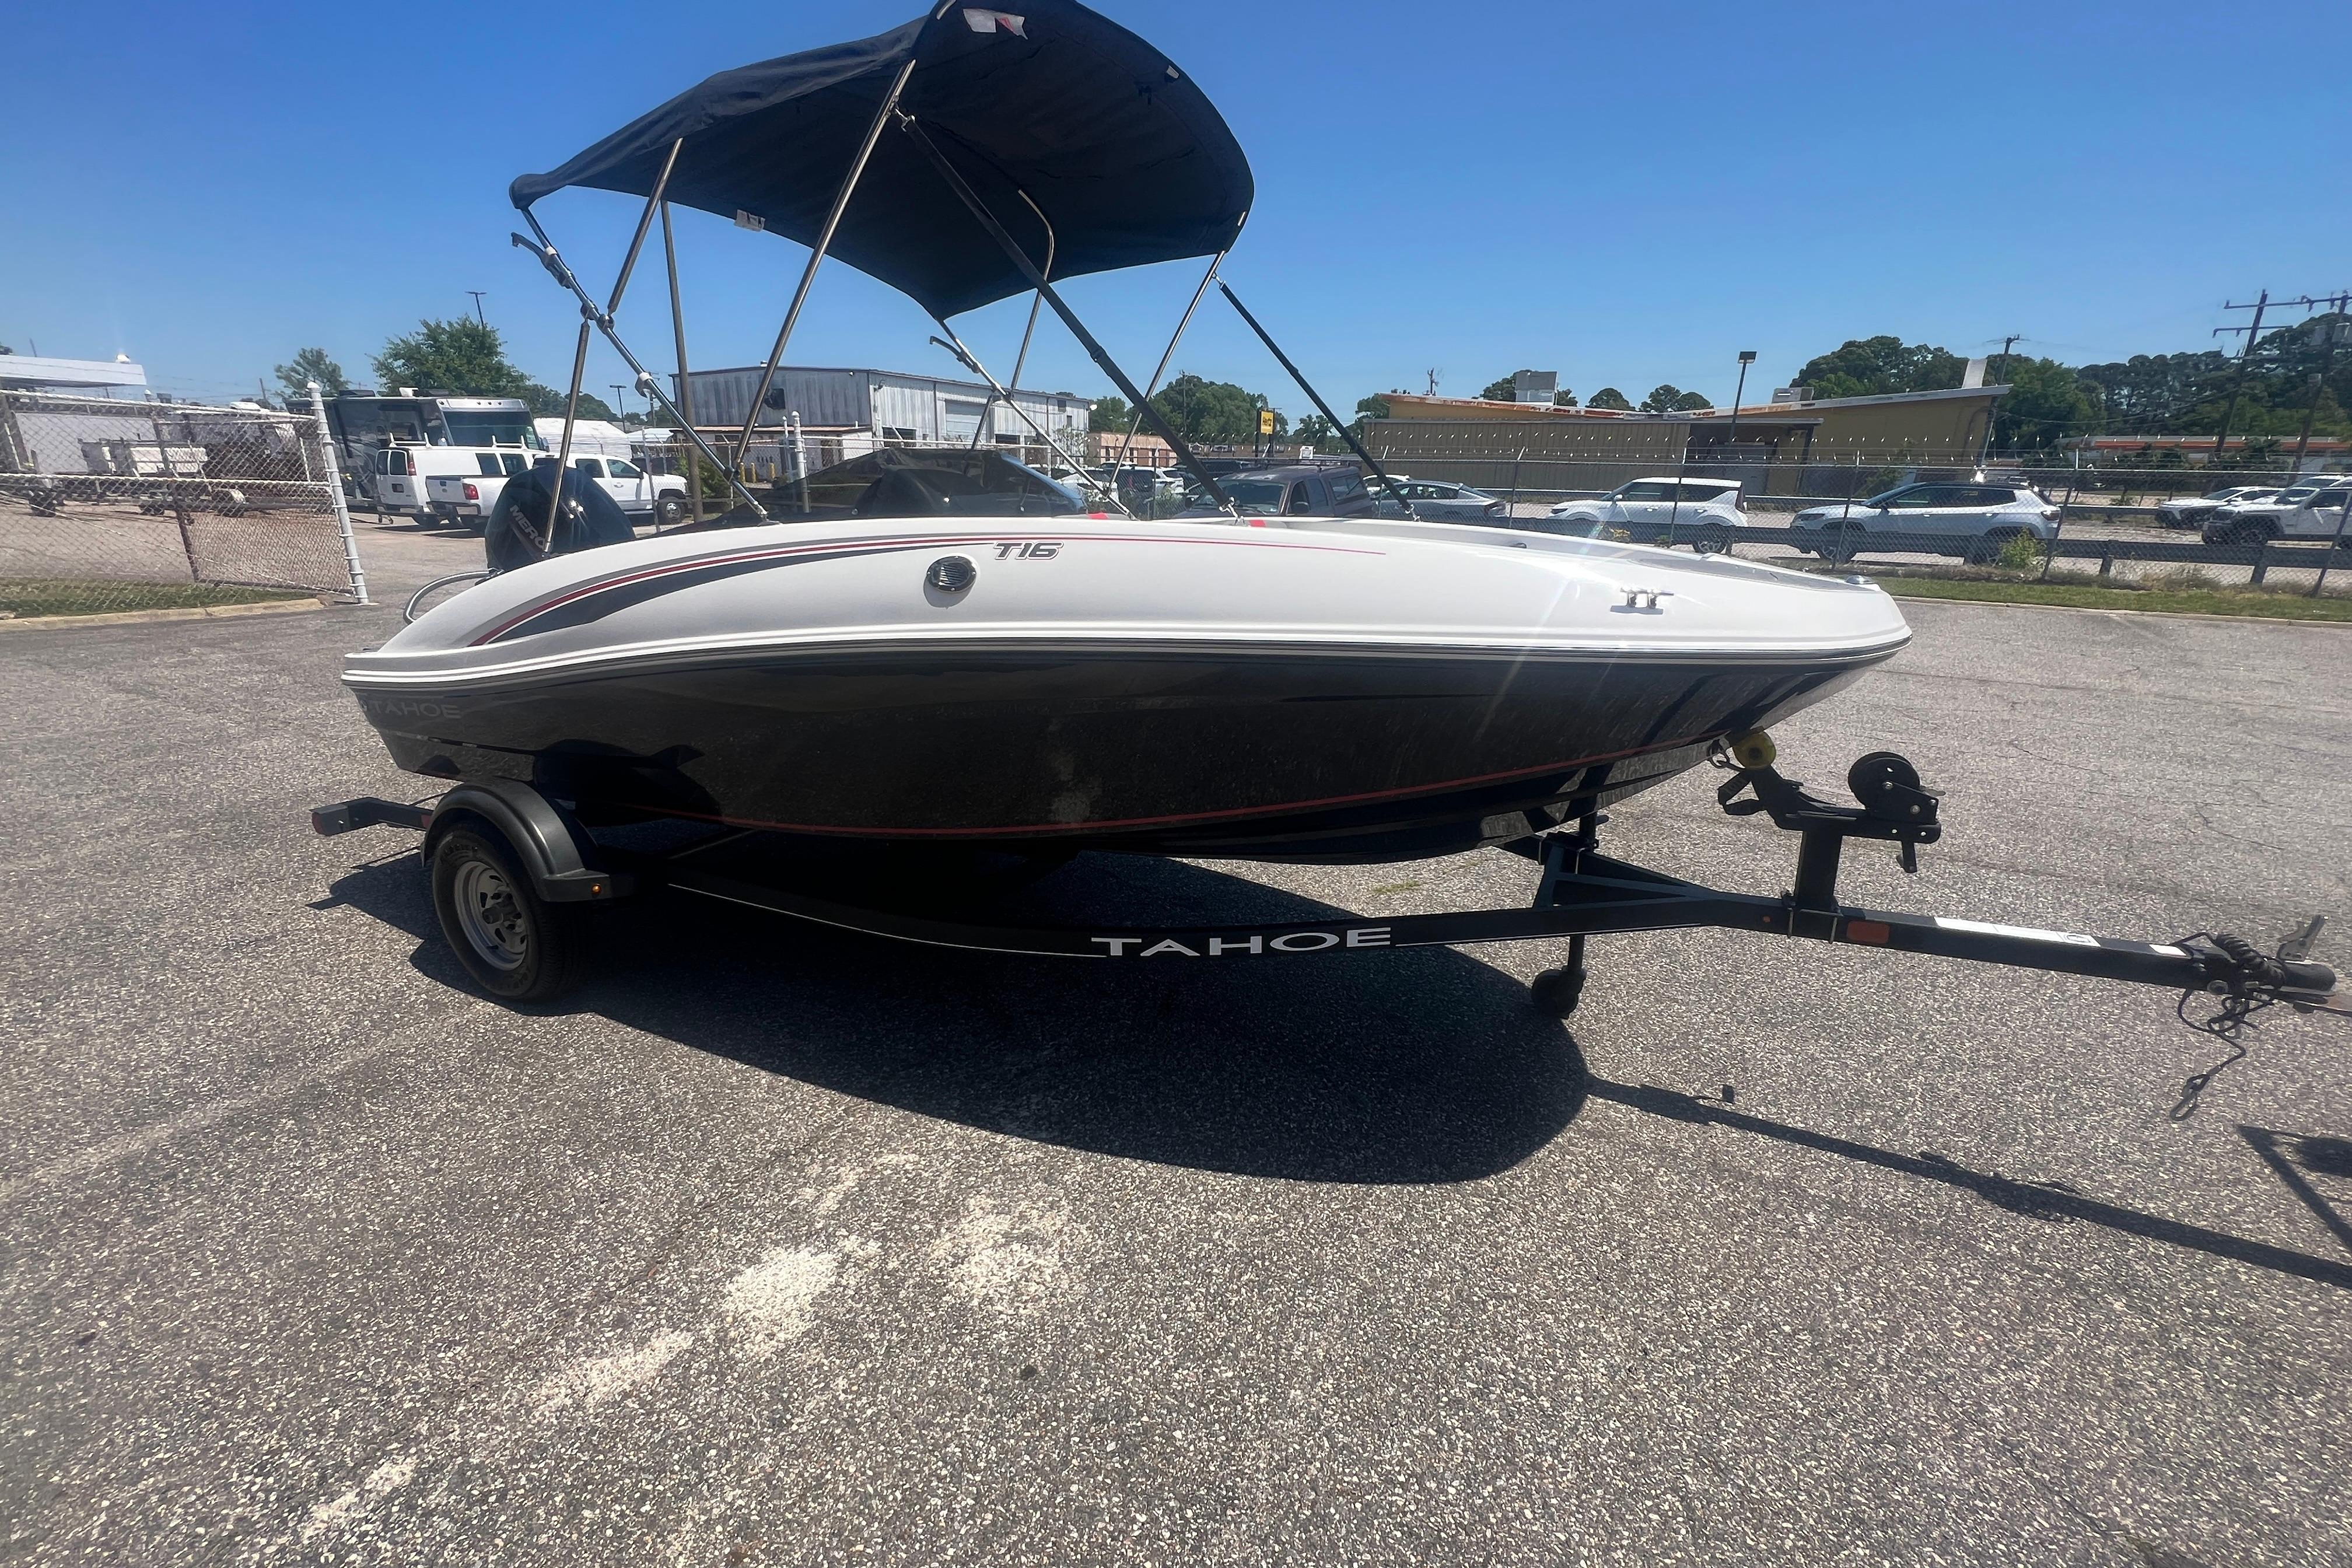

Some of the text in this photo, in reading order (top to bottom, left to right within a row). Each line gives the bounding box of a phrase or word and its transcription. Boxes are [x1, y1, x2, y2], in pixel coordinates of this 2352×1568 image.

[993, 541, 1064, 560] T16
[371, 701, 463, 719] TAHOE
[1091, 927, 1391, 957] TAHOE
